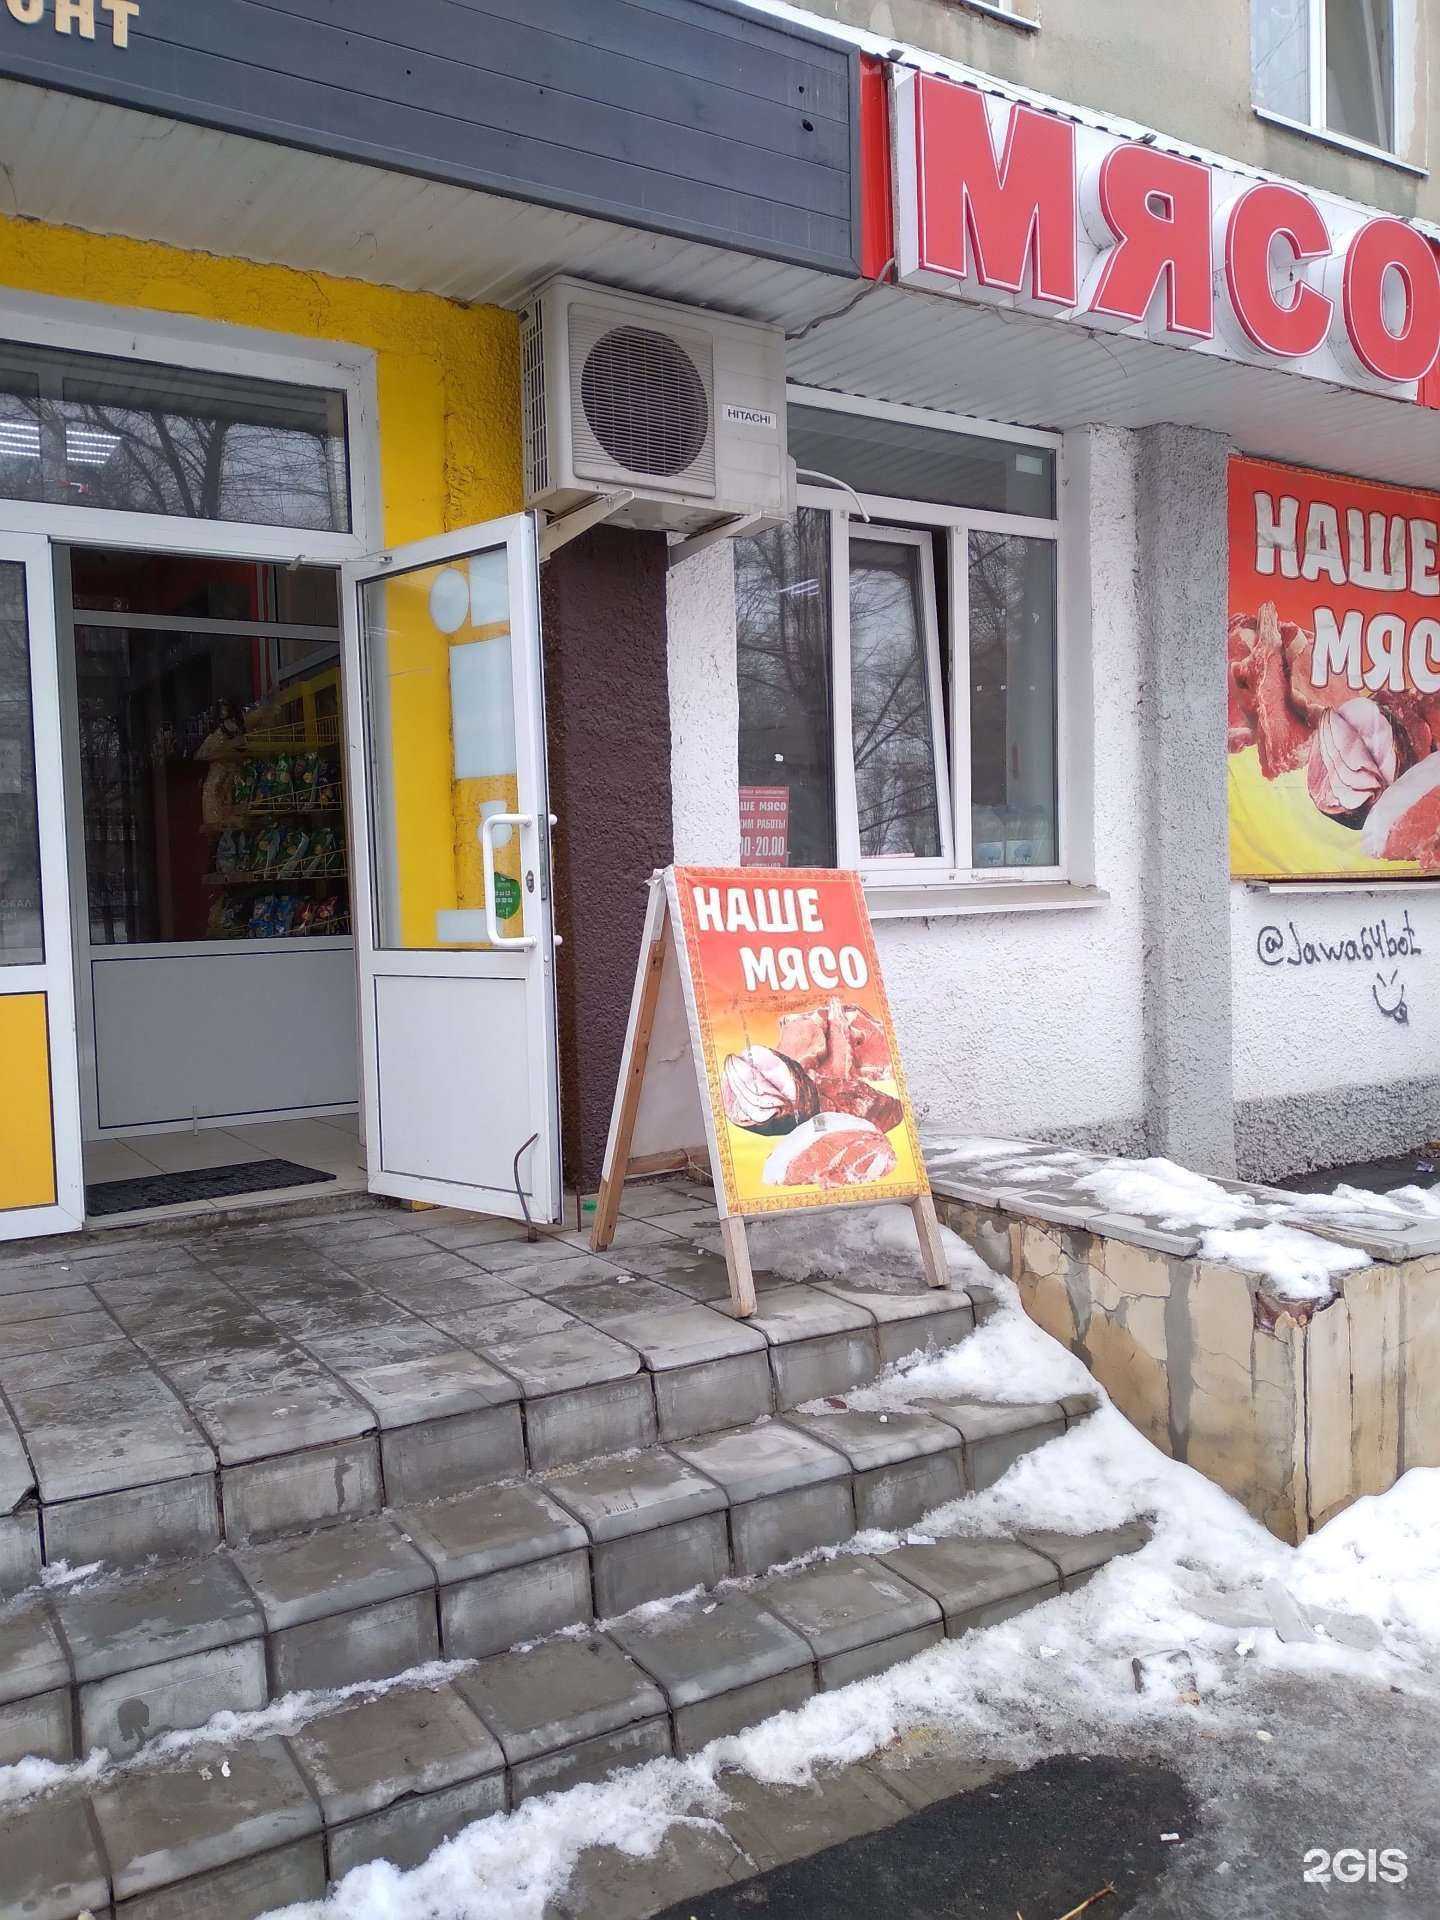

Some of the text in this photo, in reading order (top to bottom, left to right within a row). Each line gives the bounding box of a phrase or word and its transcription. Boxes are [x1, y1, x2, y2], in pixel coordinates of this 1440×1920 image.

[914, 68, 1440, 383] МЯСО
[727, 408, 771, 425] HITACHI
[1253, 490, 1440, 597] НАШЕ
[756, 818, 786, 830] РАБОТЫ
[759, 801, 787, 812] МЯСО
[692, 886, 825, 933] НАШЕ
[738, 944, 869, 992] МЯСО
